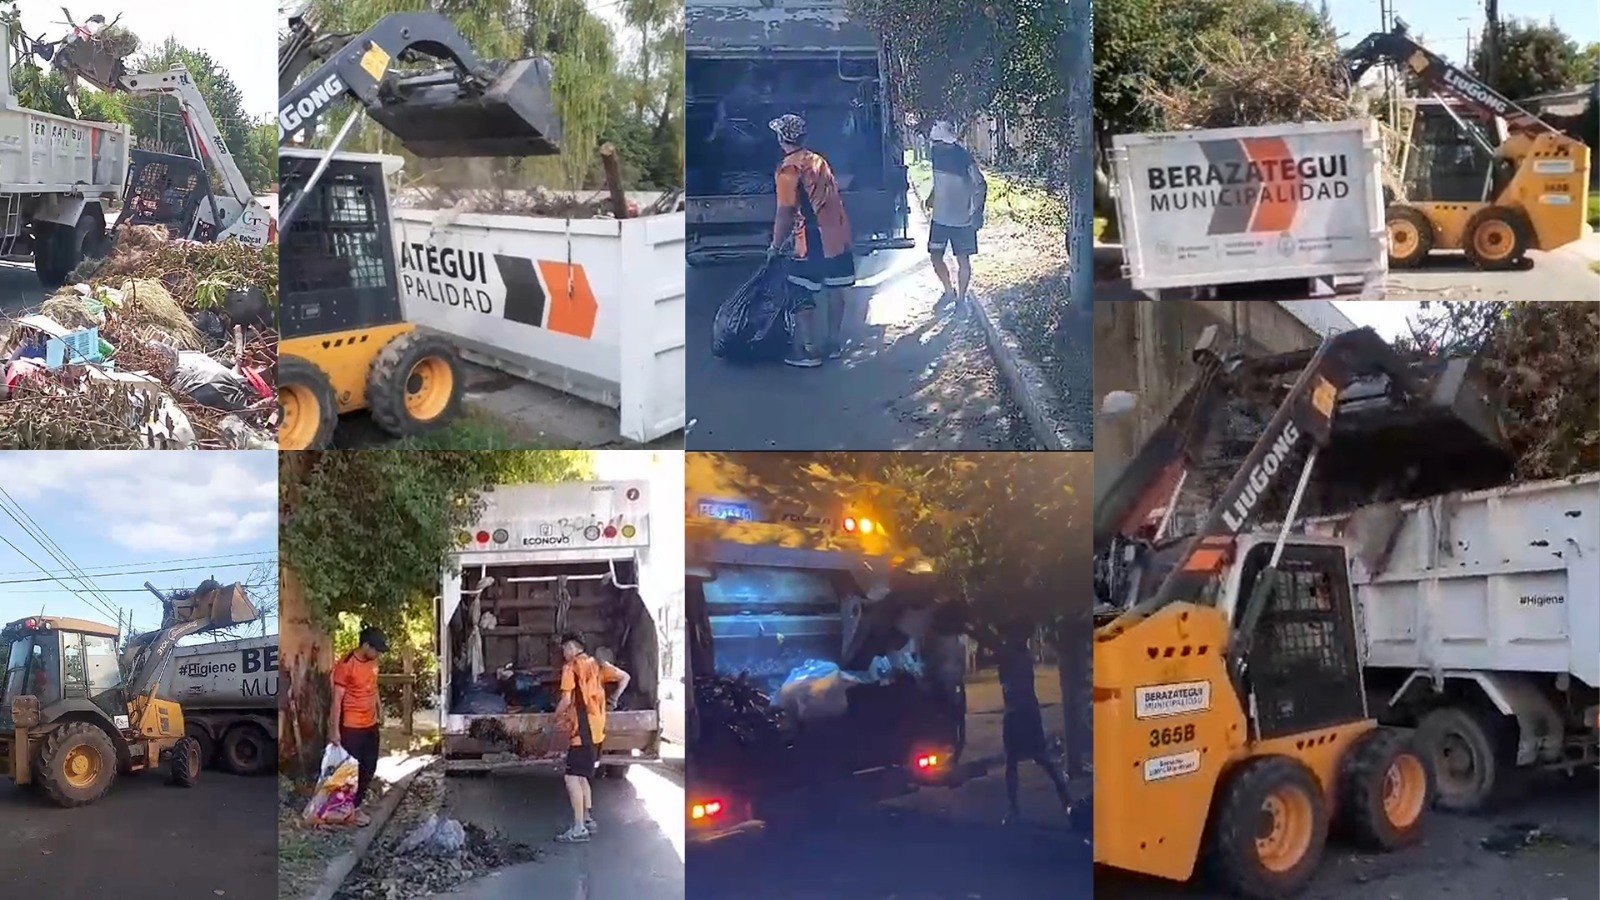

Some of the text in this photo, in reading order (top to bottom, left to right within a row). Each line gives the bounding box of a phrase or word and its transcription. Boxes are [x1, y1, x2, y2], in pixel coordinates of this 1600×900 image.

[1147, 154, 1348, 190] BERAZATEGUI
[1150, 180, 1350, 213] MUNICIPALIDAD
[403, 274, 492, 314] PALIDAD
[1221, 420, 1301, 533] LIUGONG
[523, 536, 570, 546] ECONOVO
[1520, 594, 1565, 607] #Higiene
[179, 661, 237, 678] #Higiene
[1144, 687, 1204, 702] BERAZATEGUI
[1149, 723, 1197, 748] 365B
